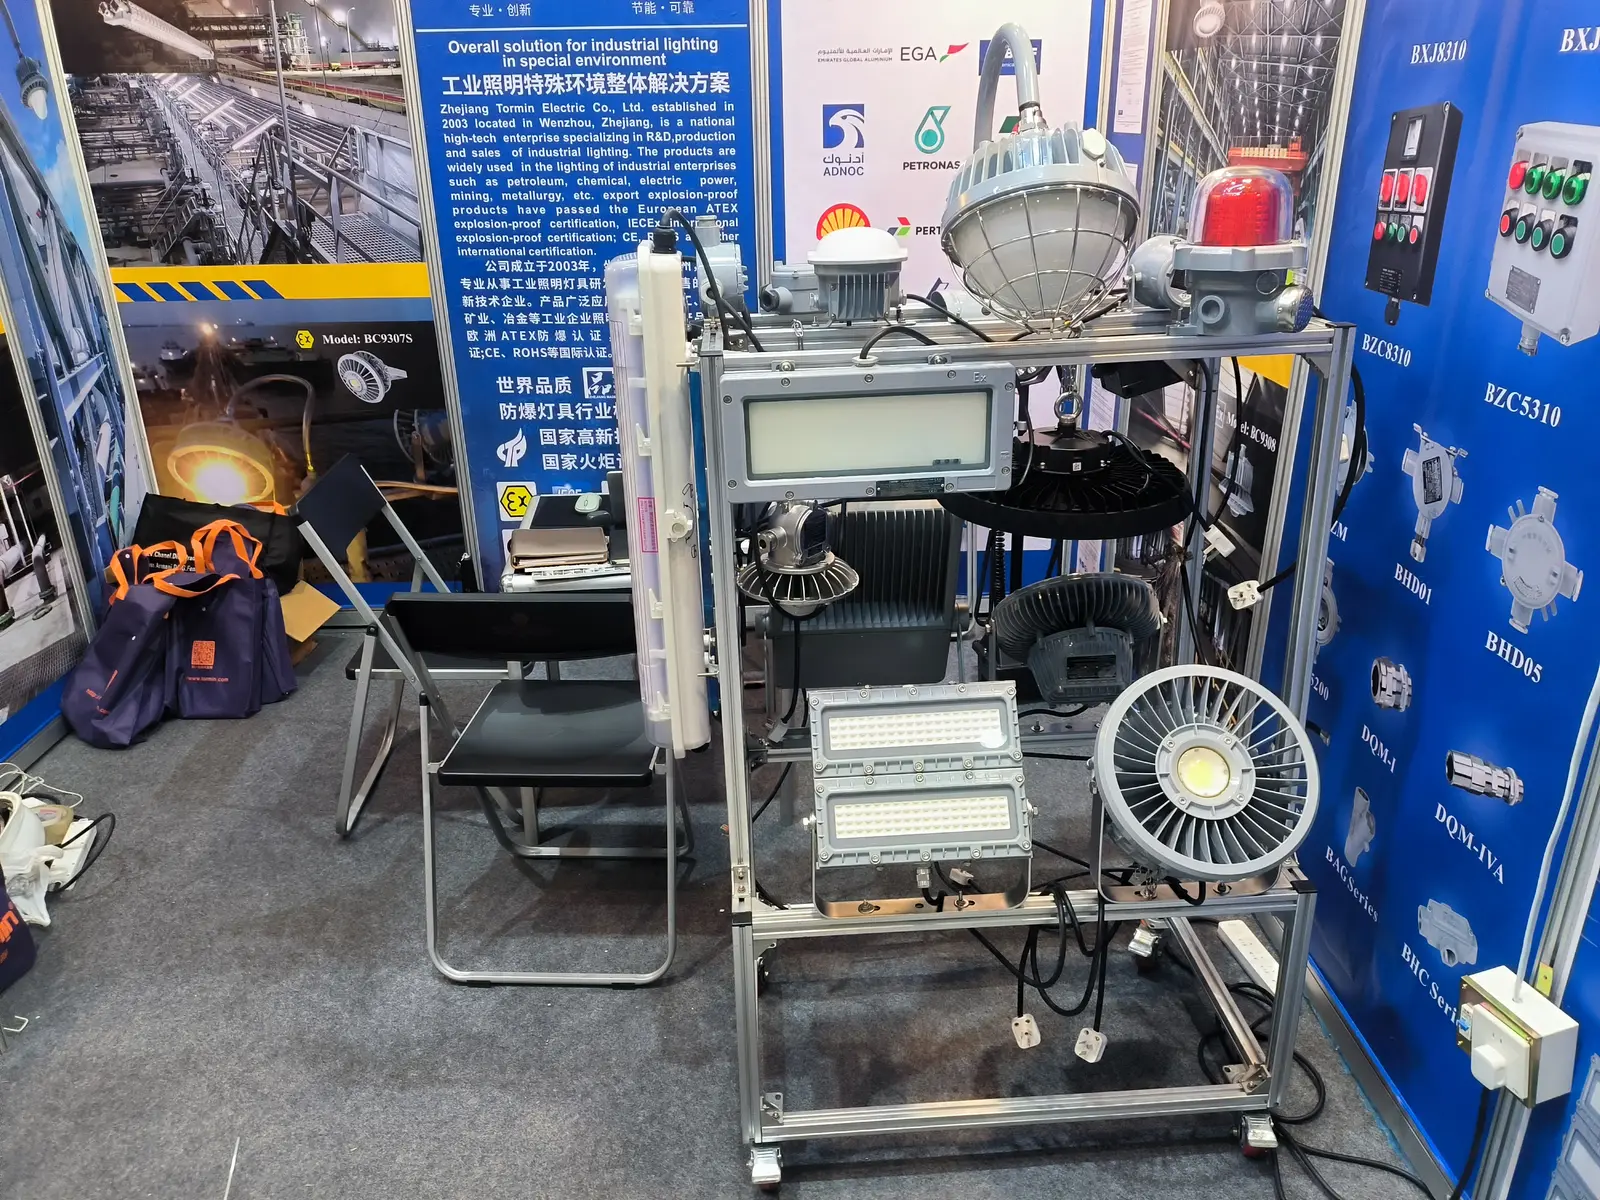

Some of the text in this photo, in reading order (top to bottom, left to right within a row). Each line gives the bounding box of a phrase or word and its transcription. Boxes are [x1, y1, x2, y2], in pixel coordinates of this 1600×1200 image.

[449, 37, 718, 54] Overall solution for industrial lighting
[1410, 39, 1466, 65] BXJ8310
[900, 46, 937, 61] EGA
[503, 53, 666, 70] in special environment
[442, 71, 730, 95] 工业照明特殊环境整体解决方案
[441, 101, 734, 116] Zhejiang Tormin Electric Co., Ltd. established in
[442, 119, 468, 128] 2003
[475, 118, 515, 128] located
[523, 118, 532, 127] in
[540, 118, 594, 128] Wenzhou,
[602, 117, 652, 129] Zhejiang,
[661, 117, 669, 126] is
[691, 117, 734, 126] national
[444, 131, 735, 145] high-tech enterprise specializing in R&D,production
[446, 148, 466, 157] and
[472, 148, 500, 157] sales
[512, 148, 522, 157] of
[528, 147, 580, 156] industrial
[587, 147, 631, 159] lighting.
[638, 147, 658, 156] The
[664, 146, 712, 158] products
[447, 161, 736, 174] widely used in the lighting of industrial enterprises
[823, 166, 864, 176] ADNOC
[903, 161, 960, 170] PETRONAS
[449, 177, 476, 186] such
[508, 177, 567, 188] petroleum,
[577, 176, 630, 186] chemical,
[640, 176, 681, 185] electric
[701, 177, 736, 186] power,
[451, 189, 737, 202] mining, metallurgy, etc. export explosion-proof
[453, 205, 507, 216] products
[518, 205, 545, 214] have
[556, 205, 599, 216] passed
[610, 205, 628, 213] the
[706, 204, 738, 213] ATEX
[455, 219, 540, 230] explosion-proof
[550, 219, 618, 229] certification,
[456, 233, 541, 244] explosion-proof
[548, 233, 616, 242] certification;
[623, 233, 642, 243] CE,
[458, 247, 596, 255] international certification.
[322, 333, 413, 344] Model: BC9307S
[1361, 333, 1412, 368] BZC8310
[973, 372, 987, 383] Ex
[496, 377, 571, 394] 世界品质
[1484, 381, 1561, 429] BZC5310
[1250, 425, 1277, 452] BC9308
[1394, 562, 1432, 606] BHD01
[1484, 629, 1543, 684] BHD05
[1360, 723, 1397, 774] DQM-I
[1434, 802, 1505, 885] DQM-IVA
[1325, 845, 1380, 923] BAG Series
[1401, 942, 1431, 989] BHC
